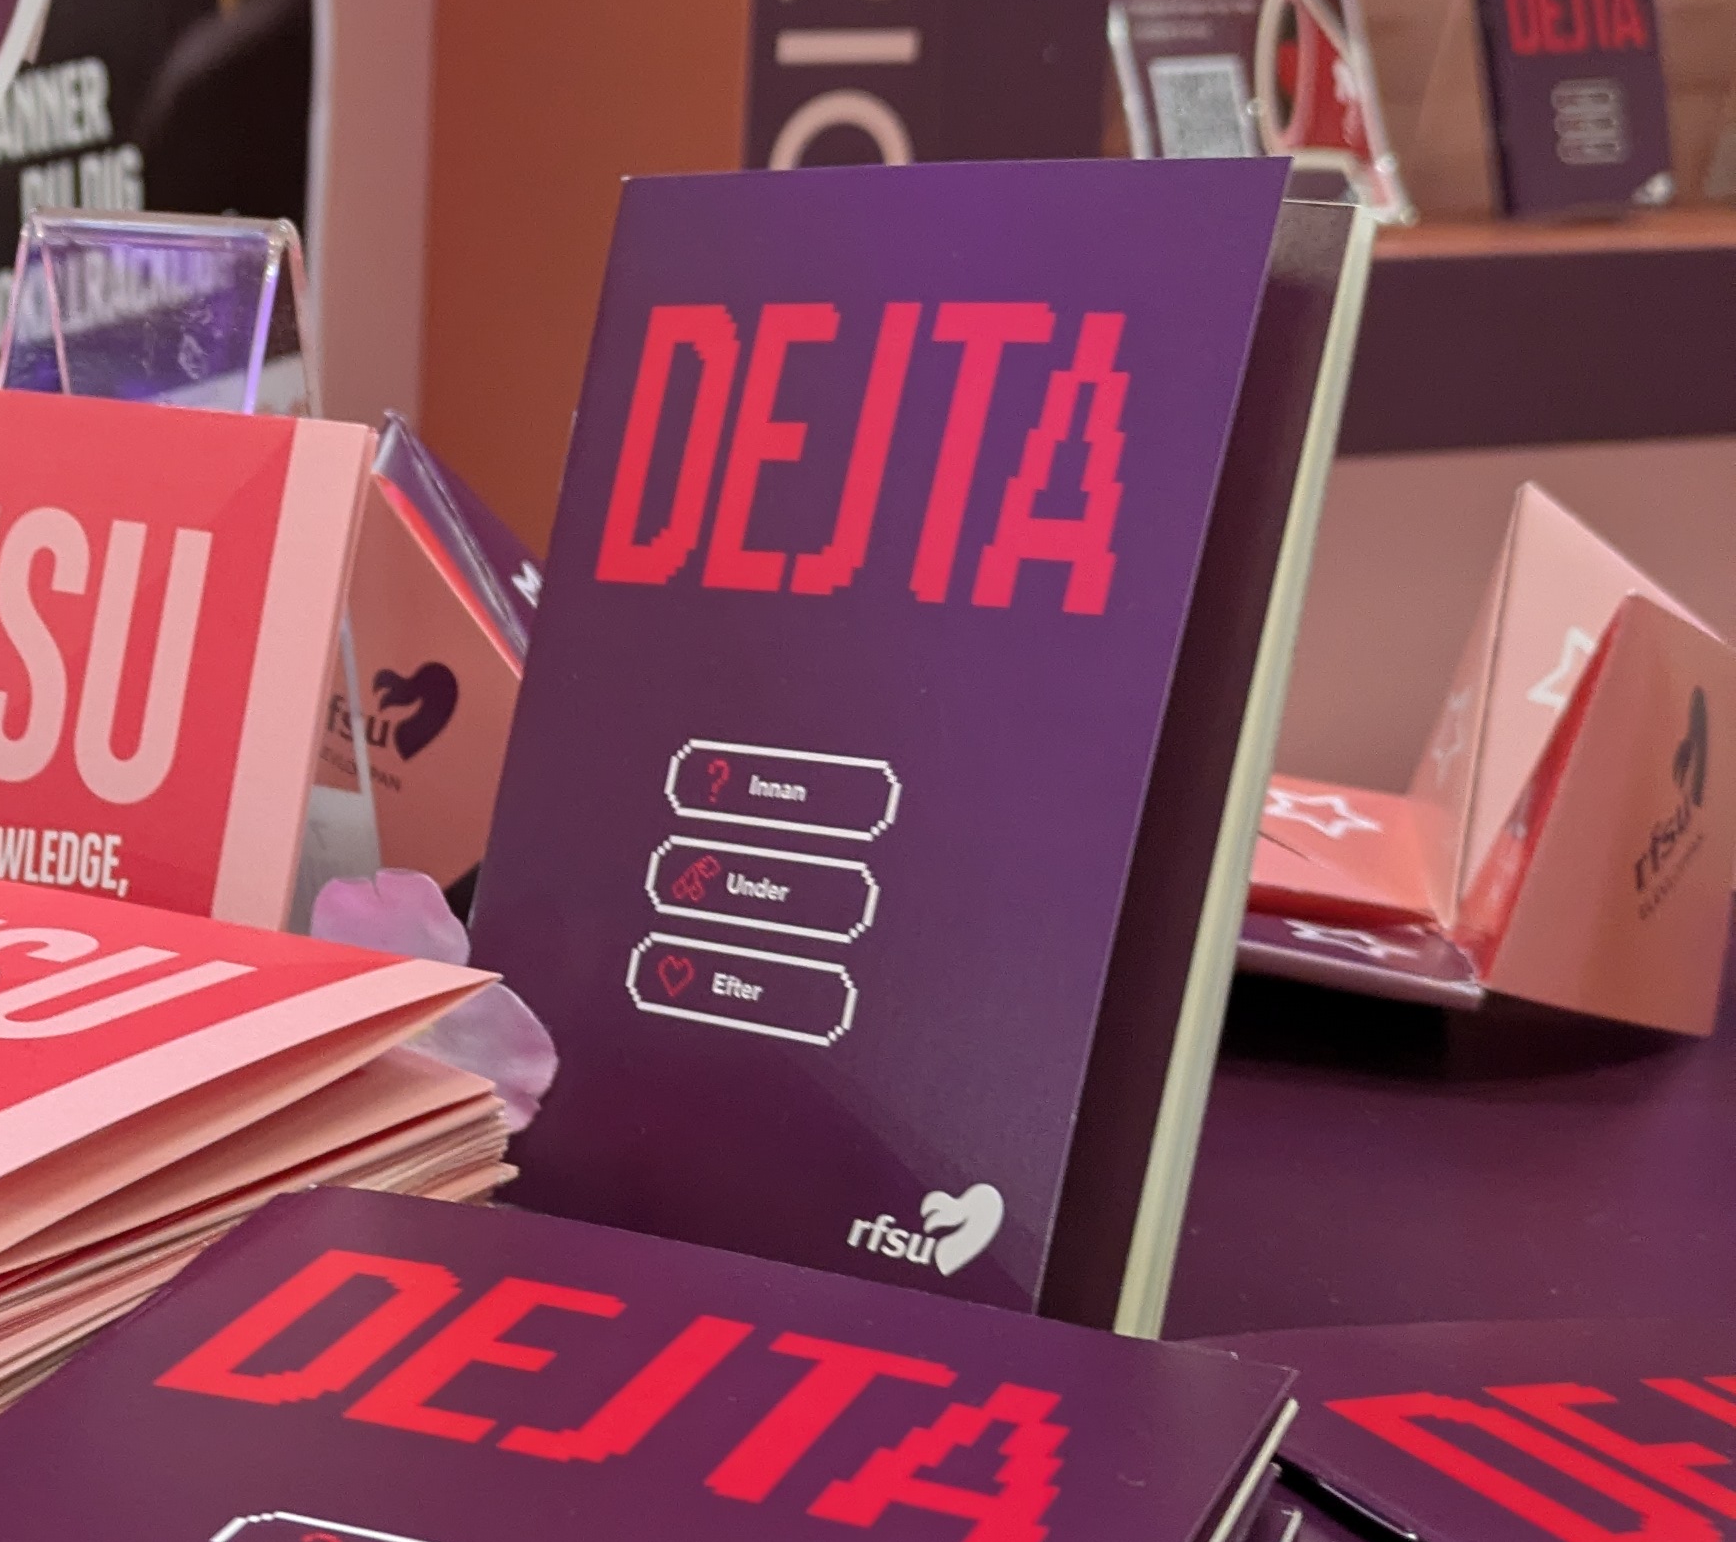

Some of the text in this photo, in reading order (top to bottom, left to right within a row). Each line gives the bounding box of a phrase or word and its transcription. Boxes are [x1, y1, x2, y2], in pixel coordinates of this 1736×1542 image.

[596, 302, 1130, 616] DEJTA
[749, 774, 807, 805] Innan
[727, 872, 790, 903] Under
[711, 971, 763, 1001] Efter
[846, 1214, 936, 1265] rfsu
